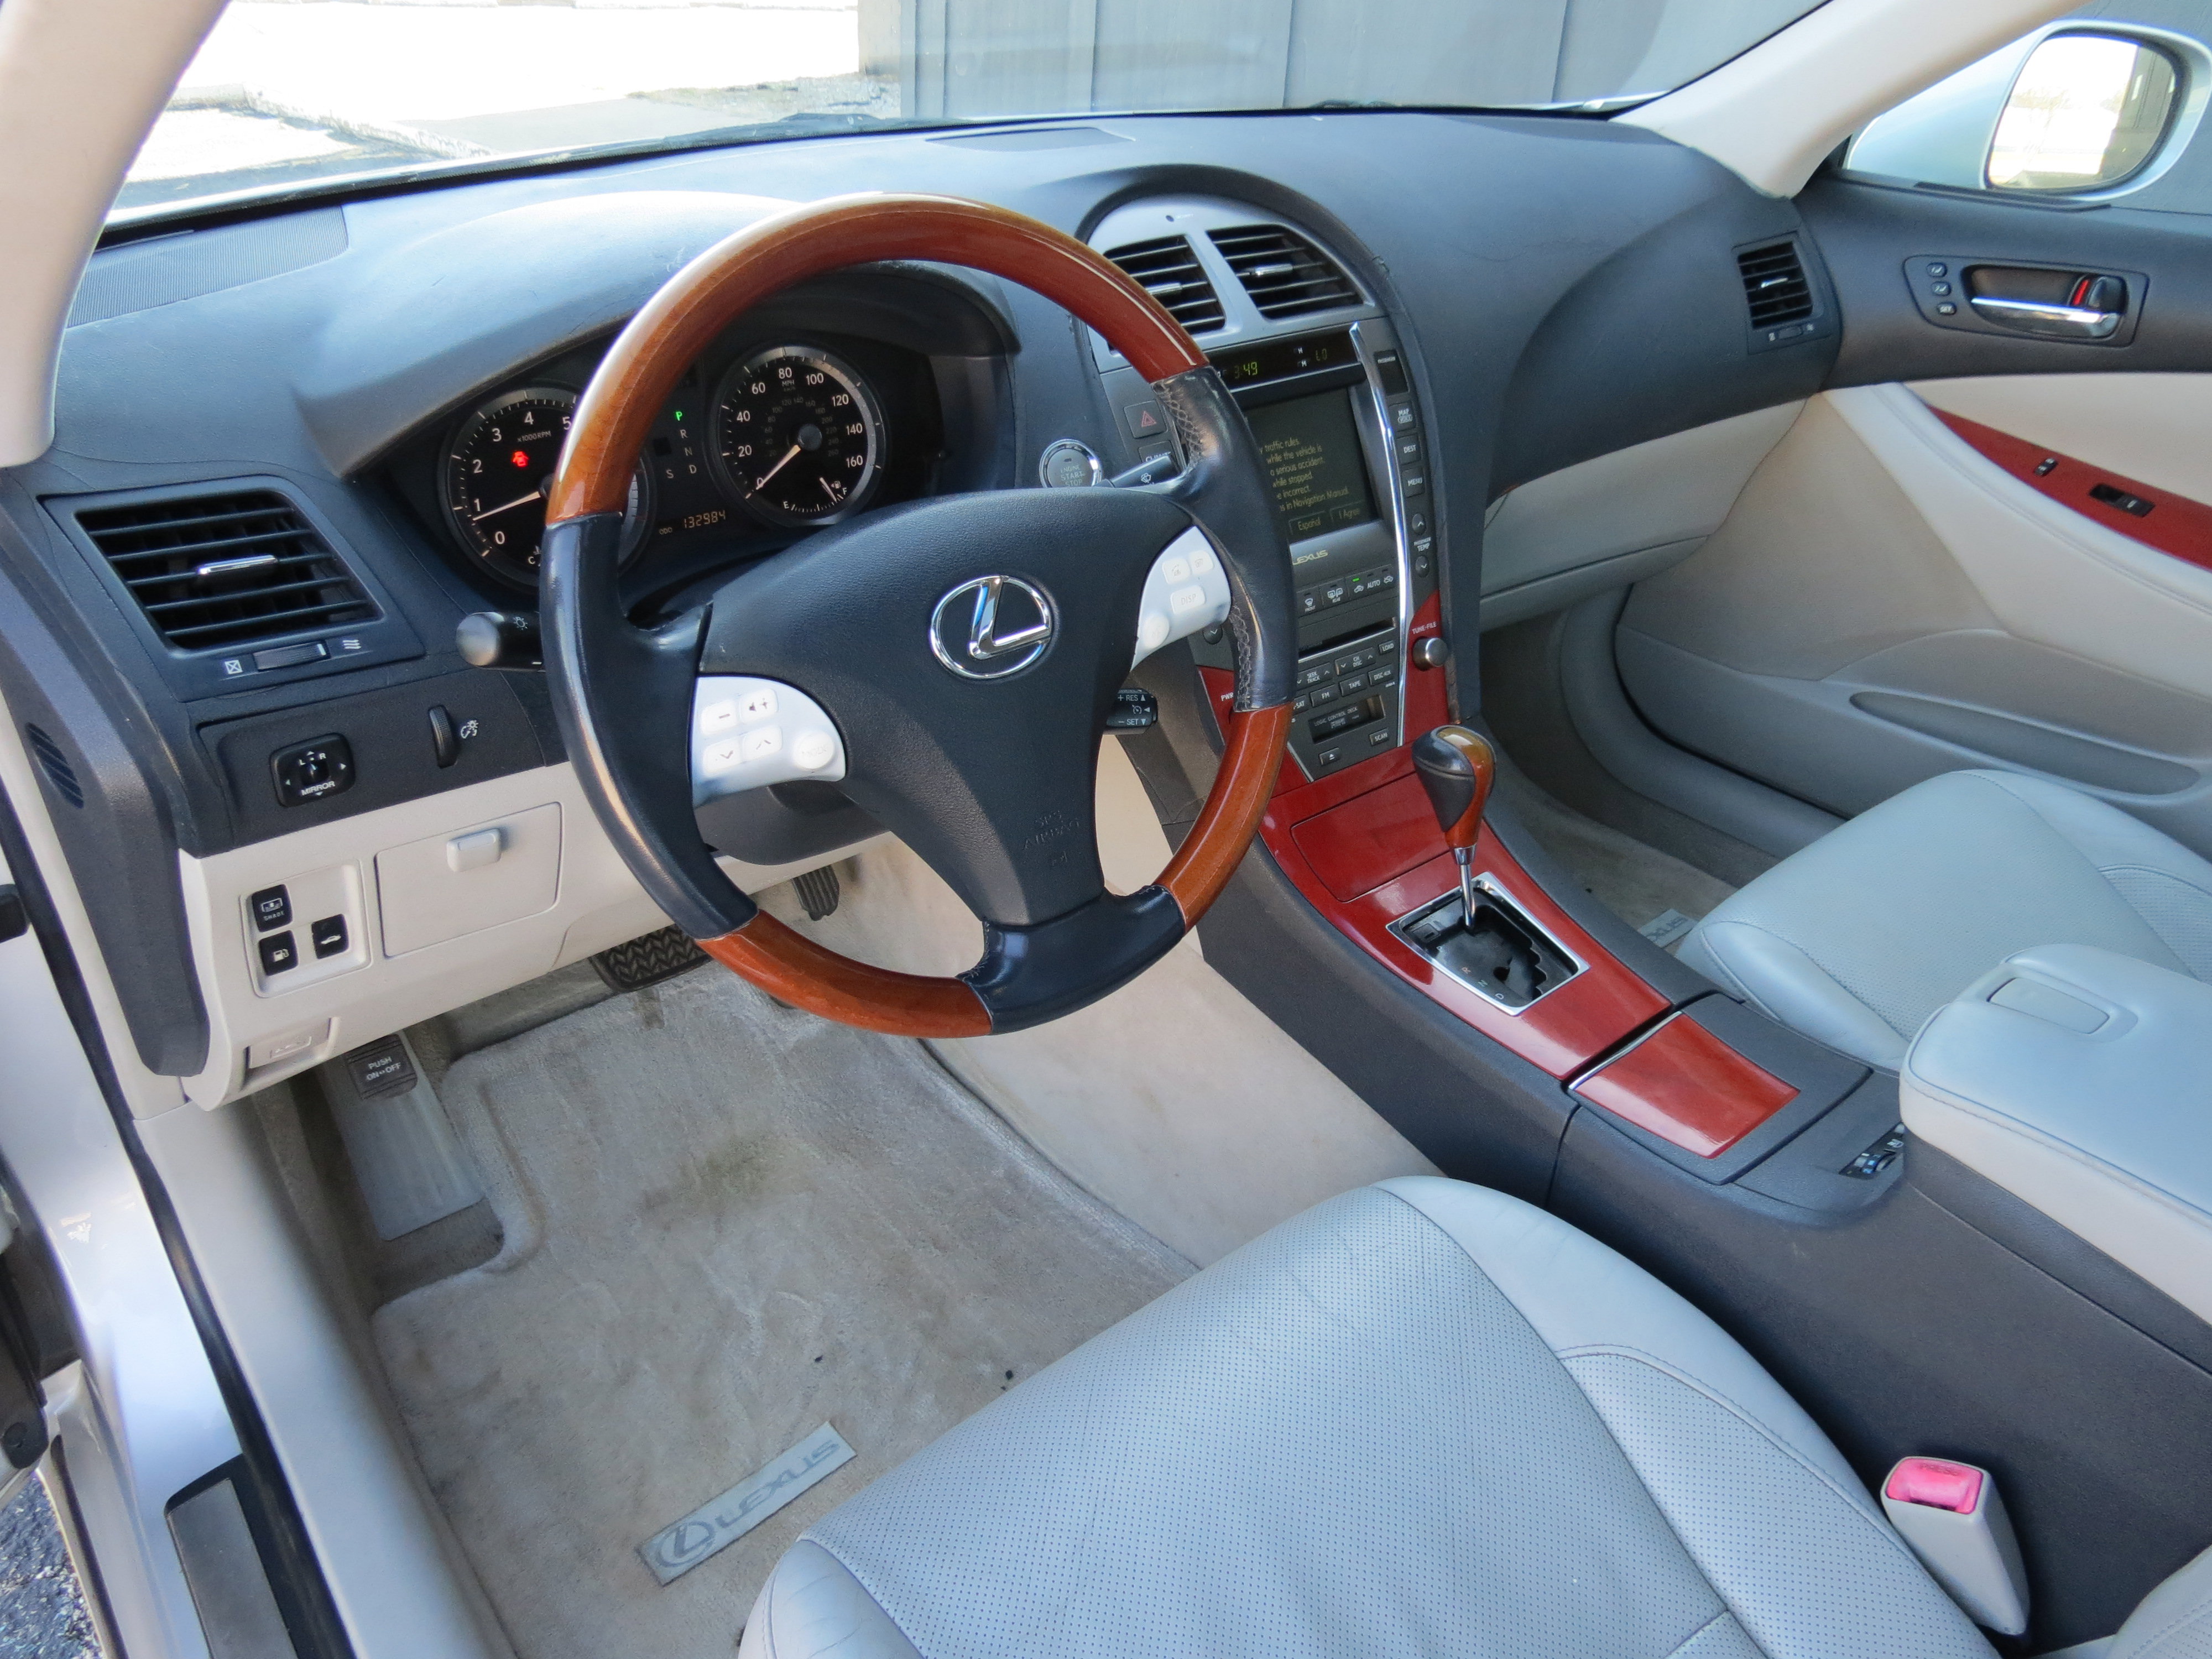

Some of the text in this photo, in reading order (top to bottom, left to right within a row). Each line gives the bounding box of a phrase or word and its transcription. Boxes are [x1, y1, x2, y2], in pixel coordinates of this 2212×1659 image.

[778, 367, 792, 379] 80
[1234, 361, 1258, 379] 3:49
[806, 373, 824, 385] 100
[752, 382, 766, 395] 60
[832, 394, 849, 406] 120
[525, 411, 534, 425] 4
[676, 411, 683, 421] P
[736, 410, 750, 422] 40
[562, 416, 571, 430] 5
[846, 422, 863, 435] 140
[492, 428, 502, 442] 3
[680, 429, 688, 439] R
[685, 447, 693, 456] N
[738, 445, 752, 457] 20
[1284, 451, 1295, 461] the
[1317, 444, 1323, 452] is
[1404, 445, 1416, 454] DEST
[473, 460, 483, 473] 2
[846, 455, 863, 468] 160
[666, 469, 674, 478] S
[689, 465, 697, 474] D
[1061, 471, 1083, 481] START
[1065, 478, 1083, 487] STOP
[1407, 477, 1423, 487] MENU
[474, 498, 481, 512] 1
[784, 501, 789, 509] E
[684, 510, 726, 529] 132984
[659, 527, 673, 535] ODO
[494, 531, 505, 545] 0
[1417, 542, 1431, 552] TEMP
[528, 556, 536, 565] C
[1367, 579, 1381, 589] AUTO
[1181, 593, 1197, 606] DISP
[1381, 643, 1394, 651] LOAD
[1307, 671, 1318, 679] SEEK
[1307, 676, 1321, 684] TRACK
[1348, 680, 1362, 690] TAPE
[1374, 732, 1389, 742] SCAN
[301, 780, 336, 796] MIRROR
[263, 910, 285, 921] SHADE
[1478, 979, 1488, 988] N
[368, 1056, 393, 1070] PUSH
[714, 1439, 841, 1528] LEXUS
